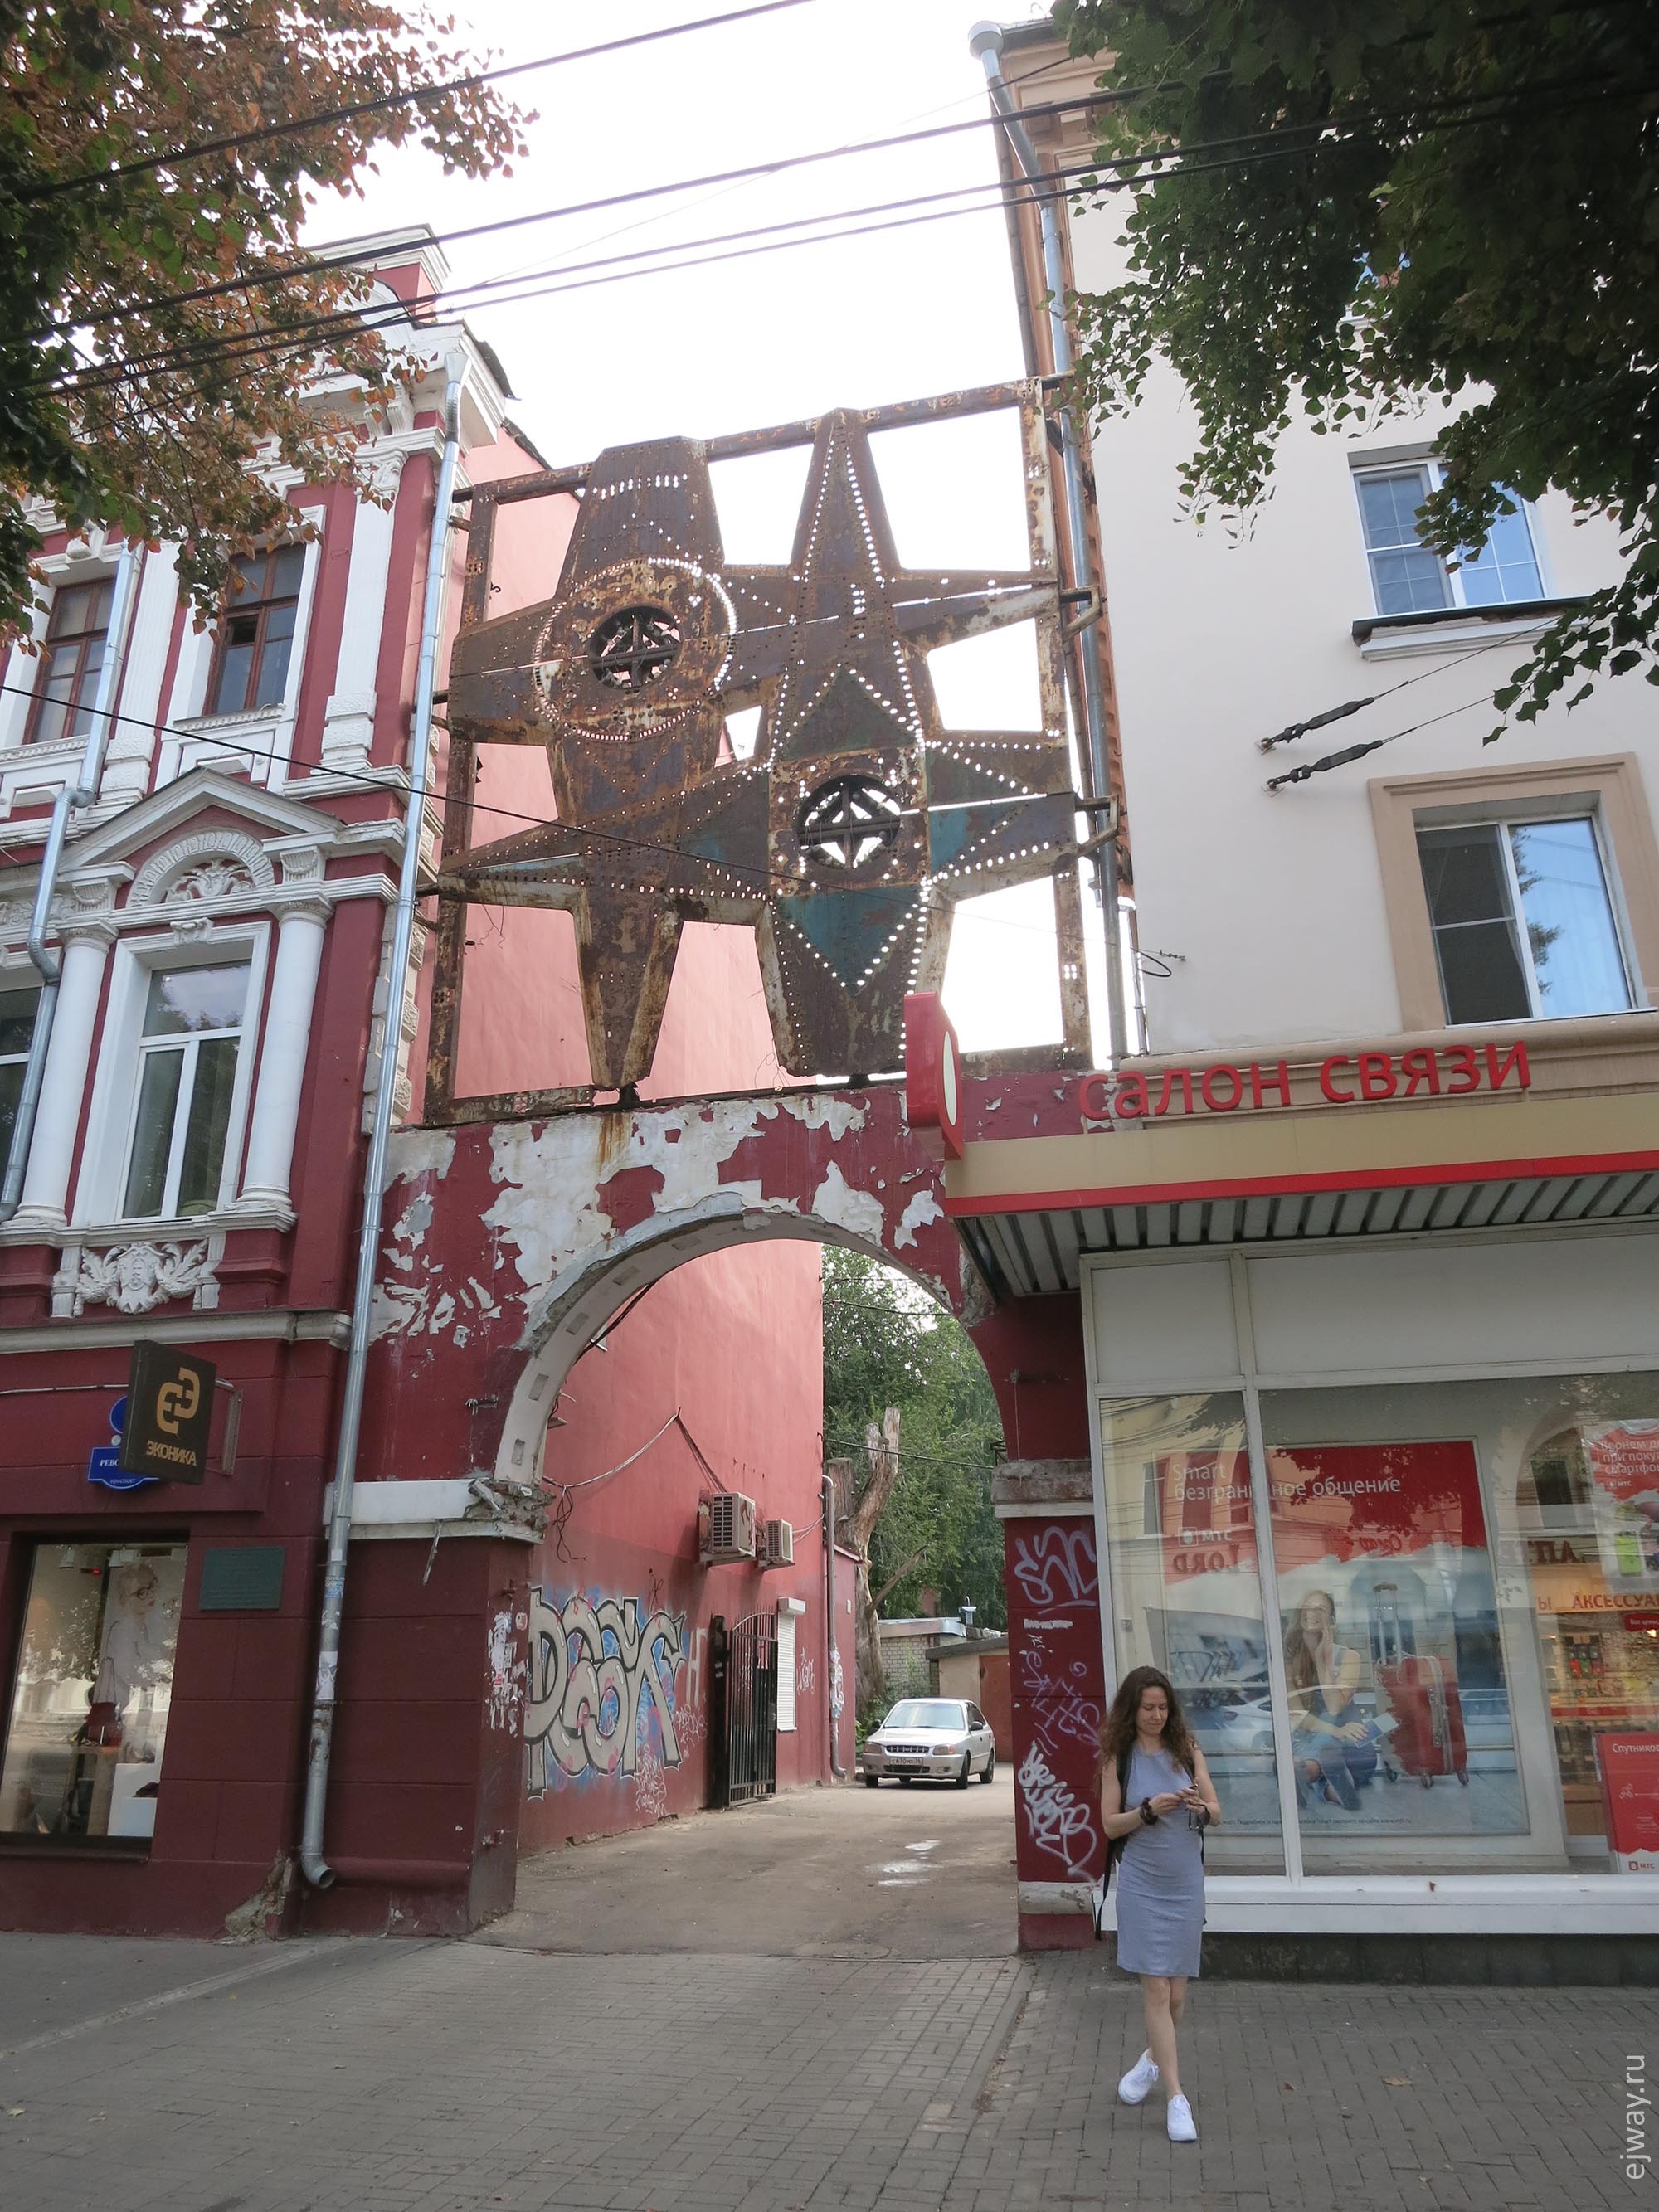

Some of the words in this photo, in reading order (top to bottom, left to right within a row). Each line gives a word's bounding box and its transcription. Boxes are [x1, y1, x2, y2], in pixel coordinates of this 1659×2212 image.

[1079, 1059, 1292, 1121] салон
[1319, 1040, 1531, 1104] связи
[146, 1440, 197, 1466] ЭКОНИКА
[1173, 1464, 1226, 1480] Smart
[1312, 1475, 1401, 1495] общение
